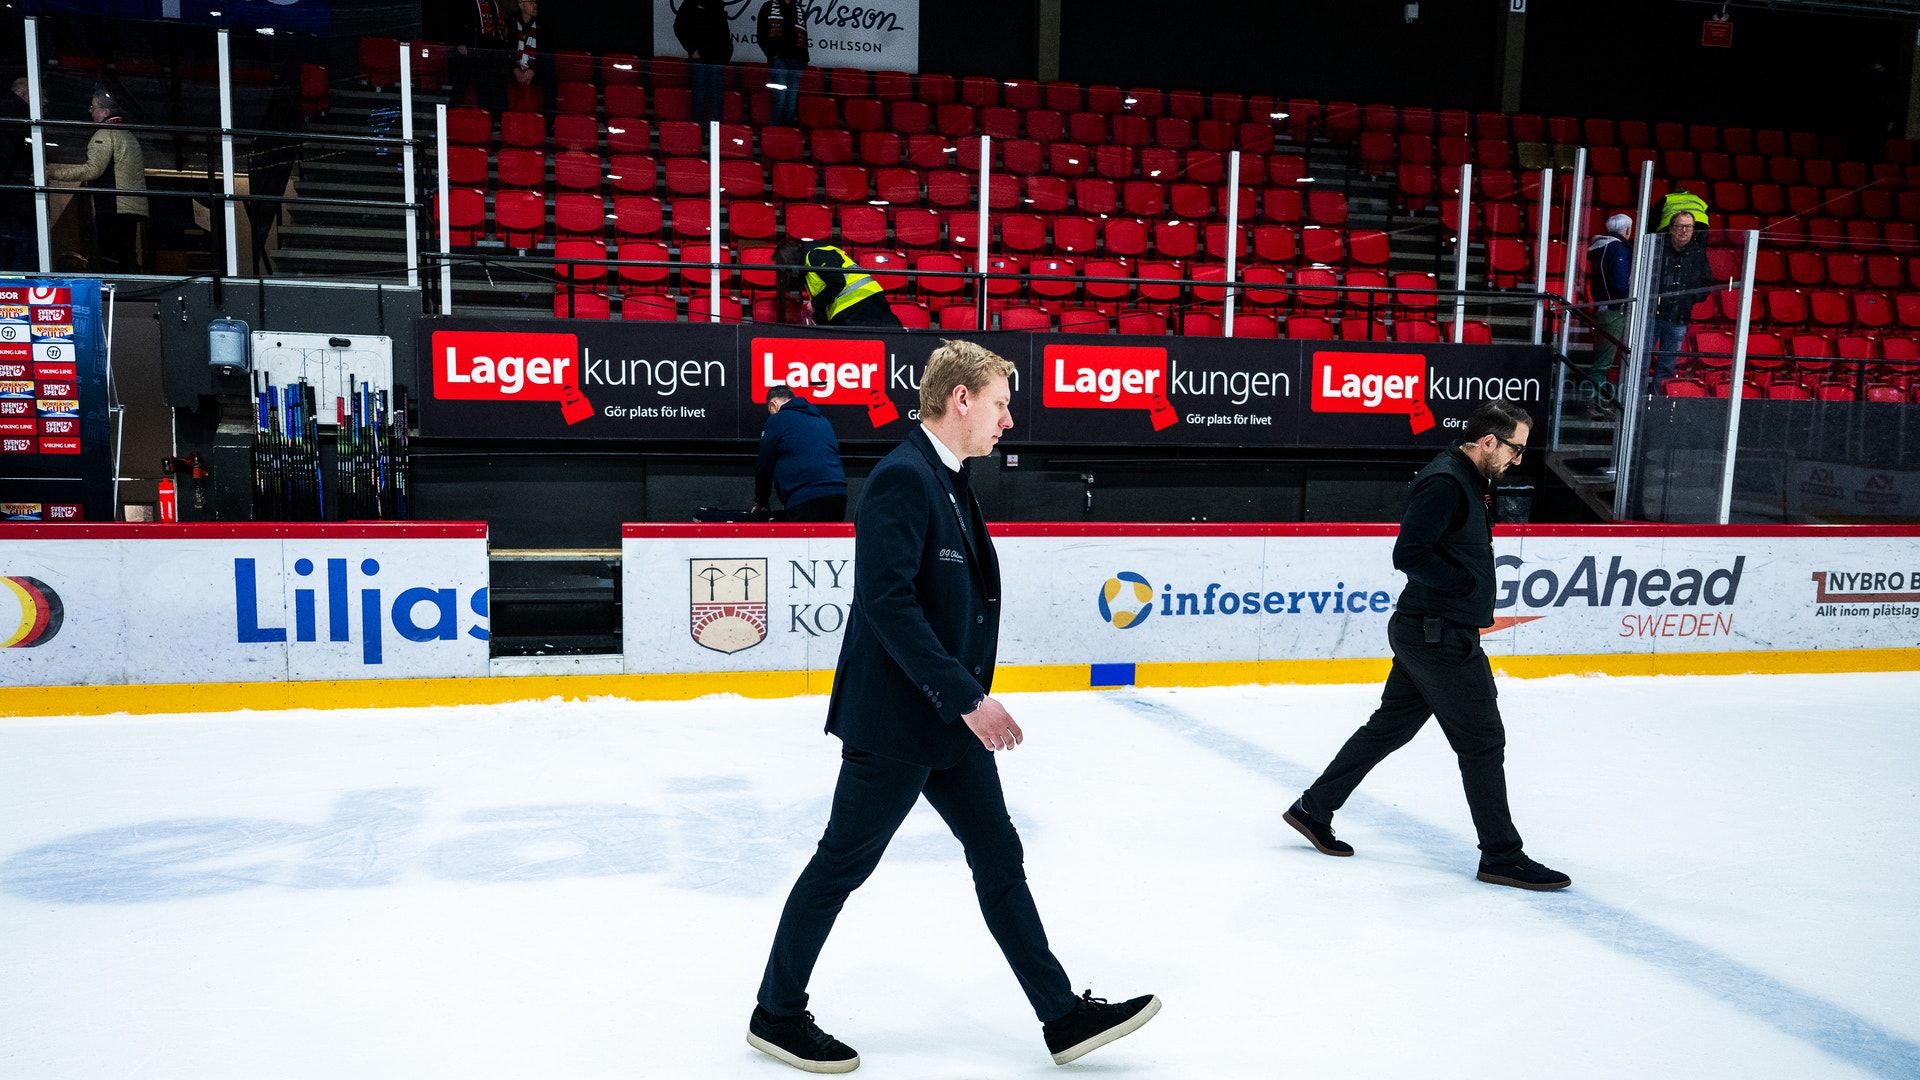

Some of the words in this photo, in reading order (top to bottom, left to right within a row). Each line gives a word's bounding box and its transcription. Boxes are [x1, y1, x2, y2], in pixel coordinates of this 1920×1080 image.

[804, 0, 904, 31] hlsson
[819, 39, 882, 52] OHLSSON
[446, 346, 570, 394] Lager
[584, 348, 726, 395] kungen
[763, 353, 878, 397] Lager
[1054, 359, 1160, 402] Lager
[1171, 360, 1290, 405] kungen
[1322, 365, 1418, 407] Lager
[1429, 367, 1540, 401] kungen
[604, 405, 628, 417] Gör
[630, 405, 658, 419] plats
[660, 406, 679, 417] för
[680, 406, 706, 418] livet
[1186, 413, 1205, 424] Gör
[1207, 414, 1231, 426] plats
[1233, 414, 1249, 425] för
[1250, 415, 1272, 425] livet
[1443, 418, 1460, 428] Gör
[788, 560, 855, 588] NY
[1495, 555, 1746, 608] GoAhead
[1830, 572, 1904, 591] NYBRO
[1161, 582, 1390, 615] infoservice
[1816, 605, 1837, 617] Allt
[1840, 605, 1869, 616] inom
[788, 603, 851, 636] KO
[1619, 613, 1733, 637] SWEDEN
